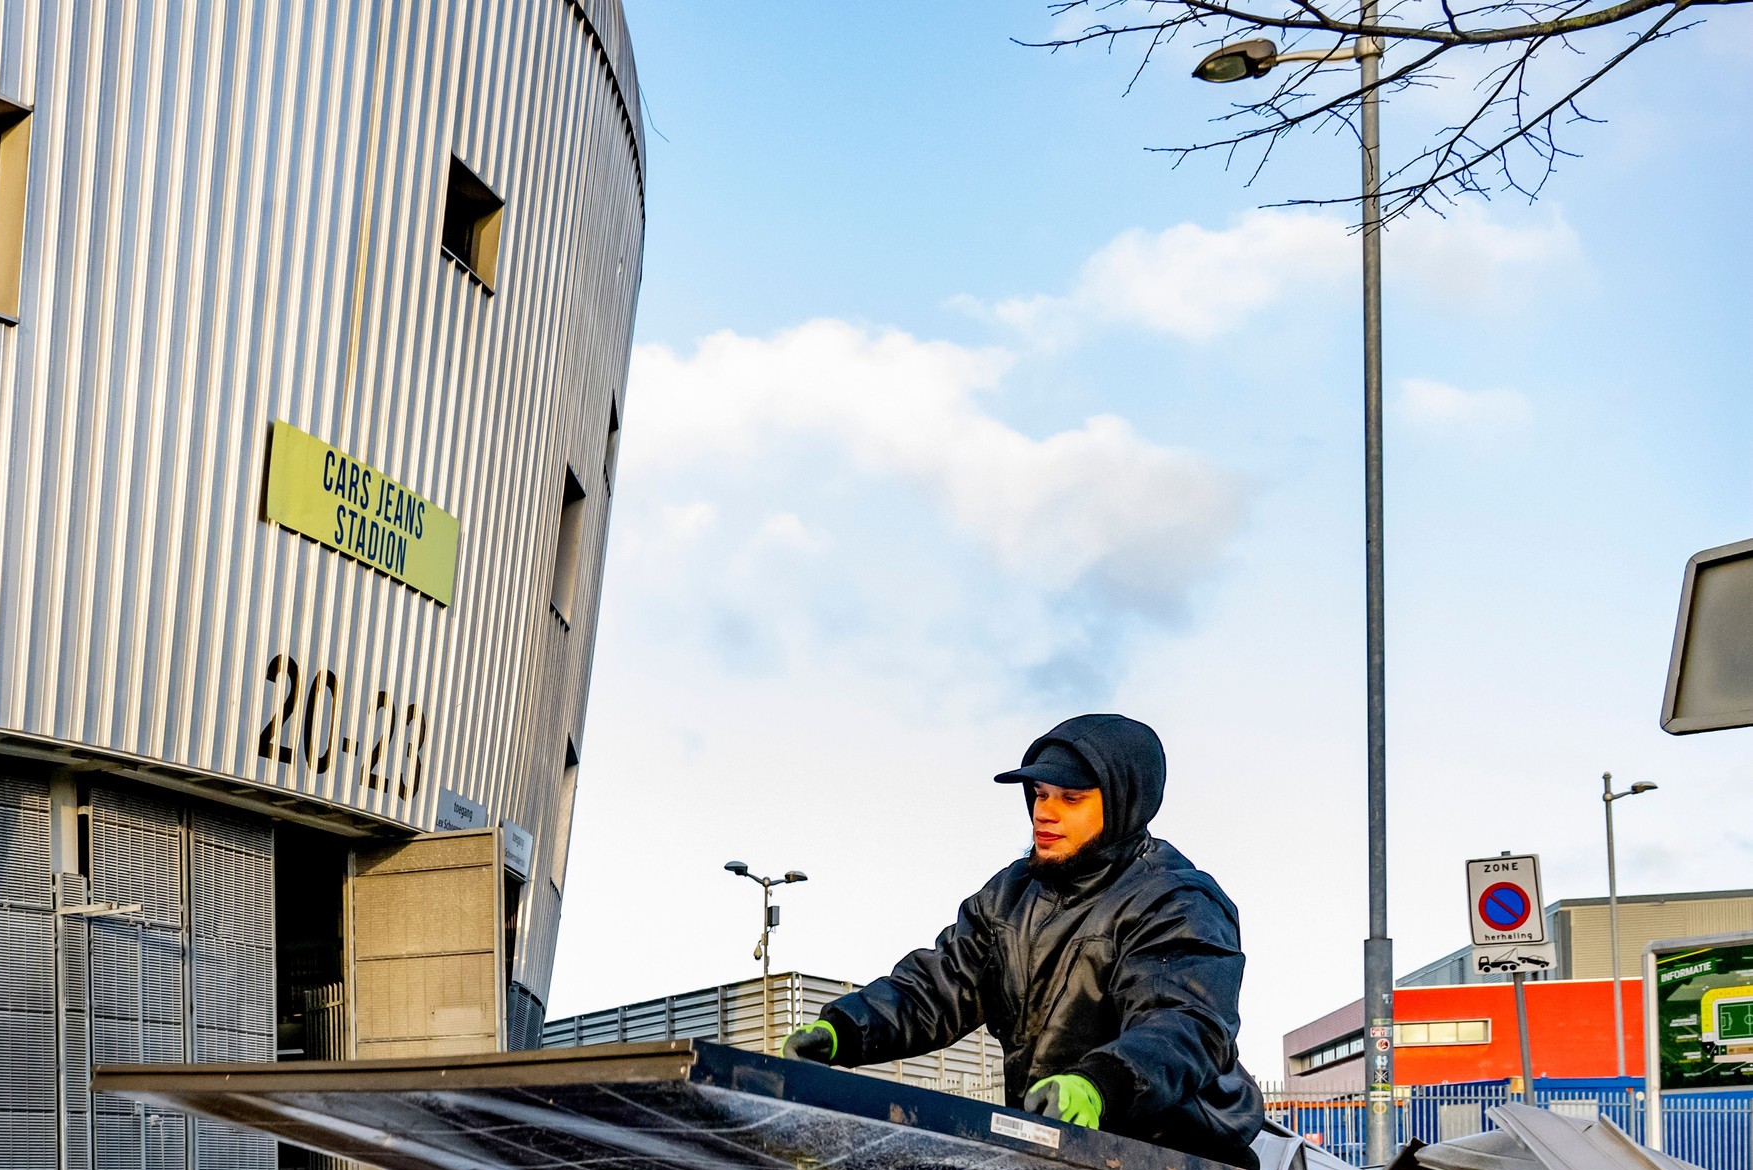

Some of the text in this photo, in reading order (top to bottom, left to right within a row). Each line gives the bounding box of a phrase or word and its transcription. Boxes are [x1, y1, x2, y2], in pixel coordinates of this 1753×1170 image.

[323, 450, 425, 540] CARS JEANS
[334, 504, 407, 576] STADION
[257, 653, 427, 801] 20-23
[453, 801, 473, 823] toegang
[1483, 862, 1519, 873] ZONE
[1484, 932, 1533, 941] herhaling
[1660, 961, 1712, 982] INFORMATIE
